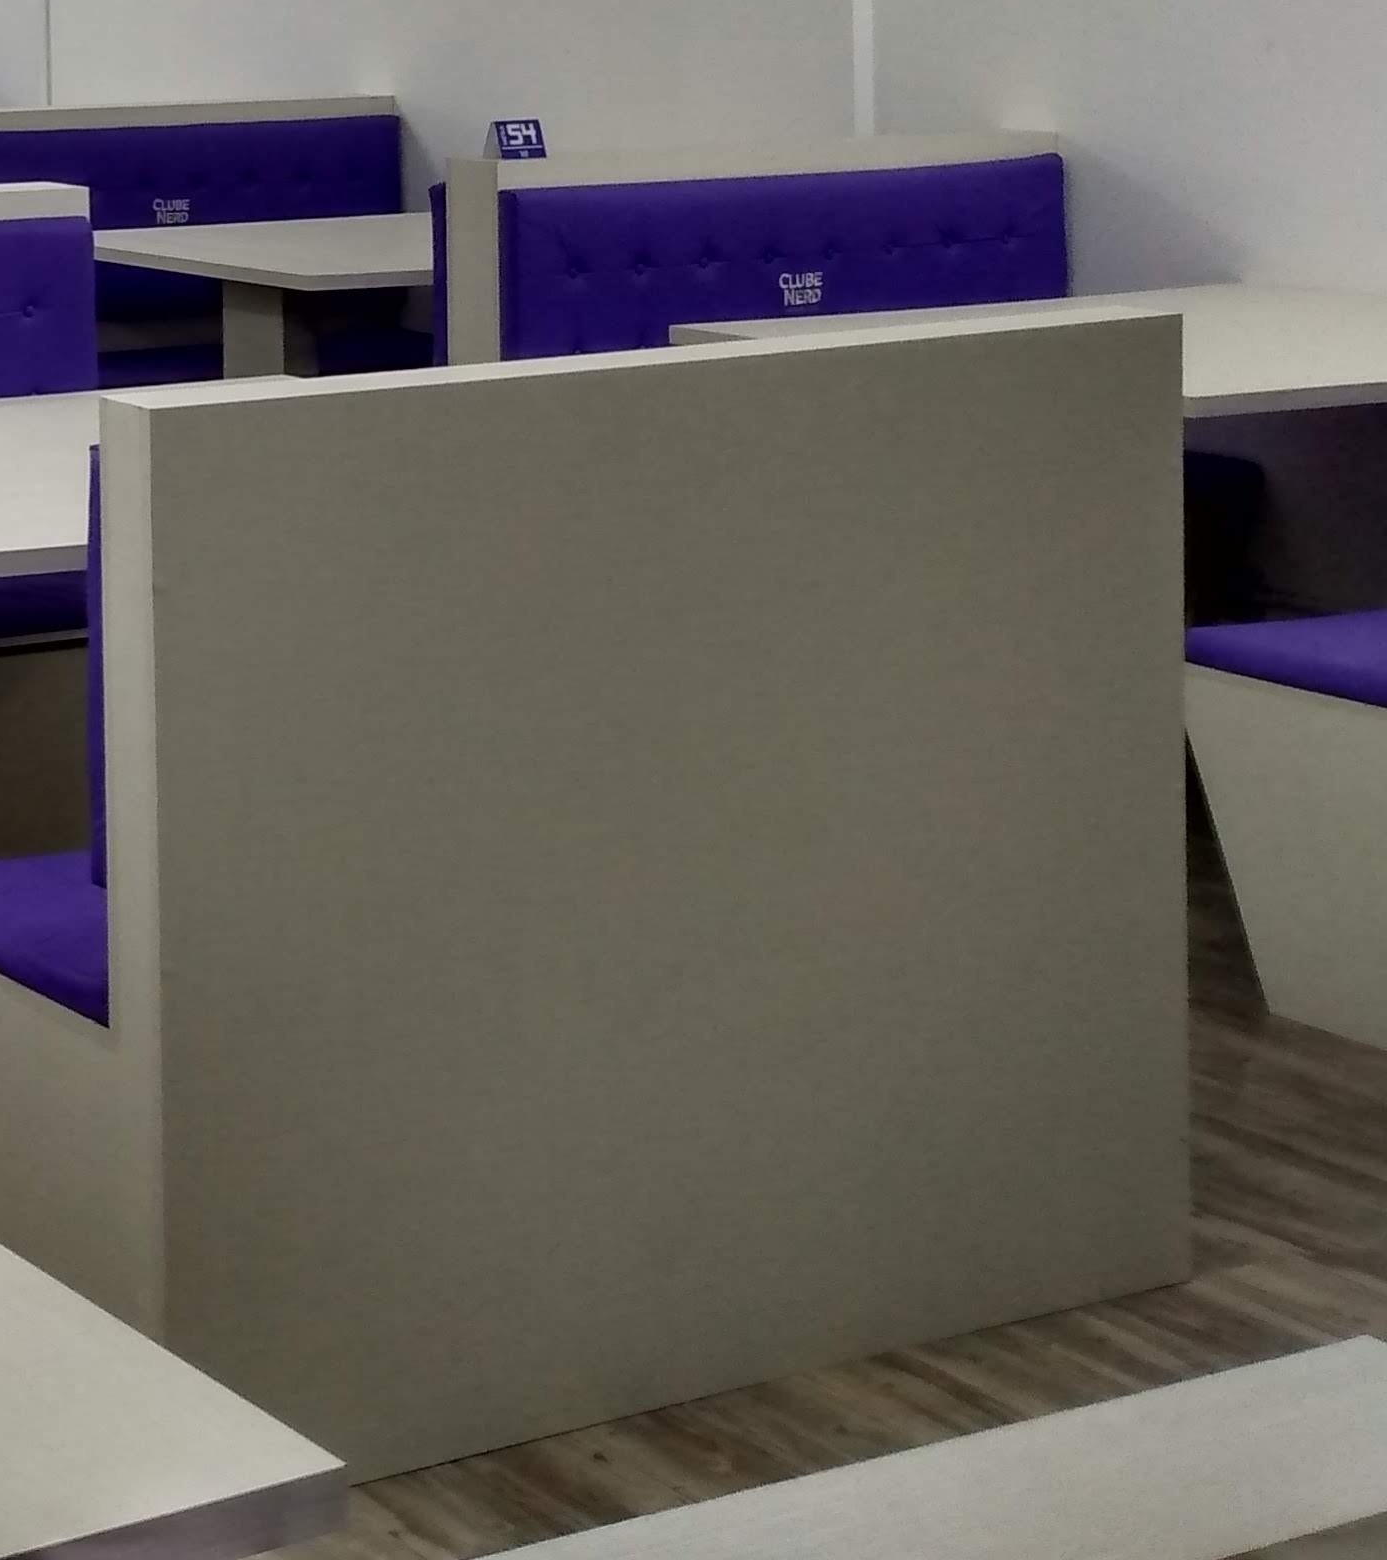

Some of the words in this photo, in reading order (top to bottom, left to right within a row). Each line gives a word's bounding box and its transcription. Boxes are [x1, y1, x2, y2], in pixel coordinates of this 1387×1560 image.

[505, 123, 538, 145] 54
[153, 198, 191, 211] CLUBE
[156, 210, 189, 225] NERD
[778, 271, 824, 289] CLUBE
[784, 288, 822, 307] NERD
